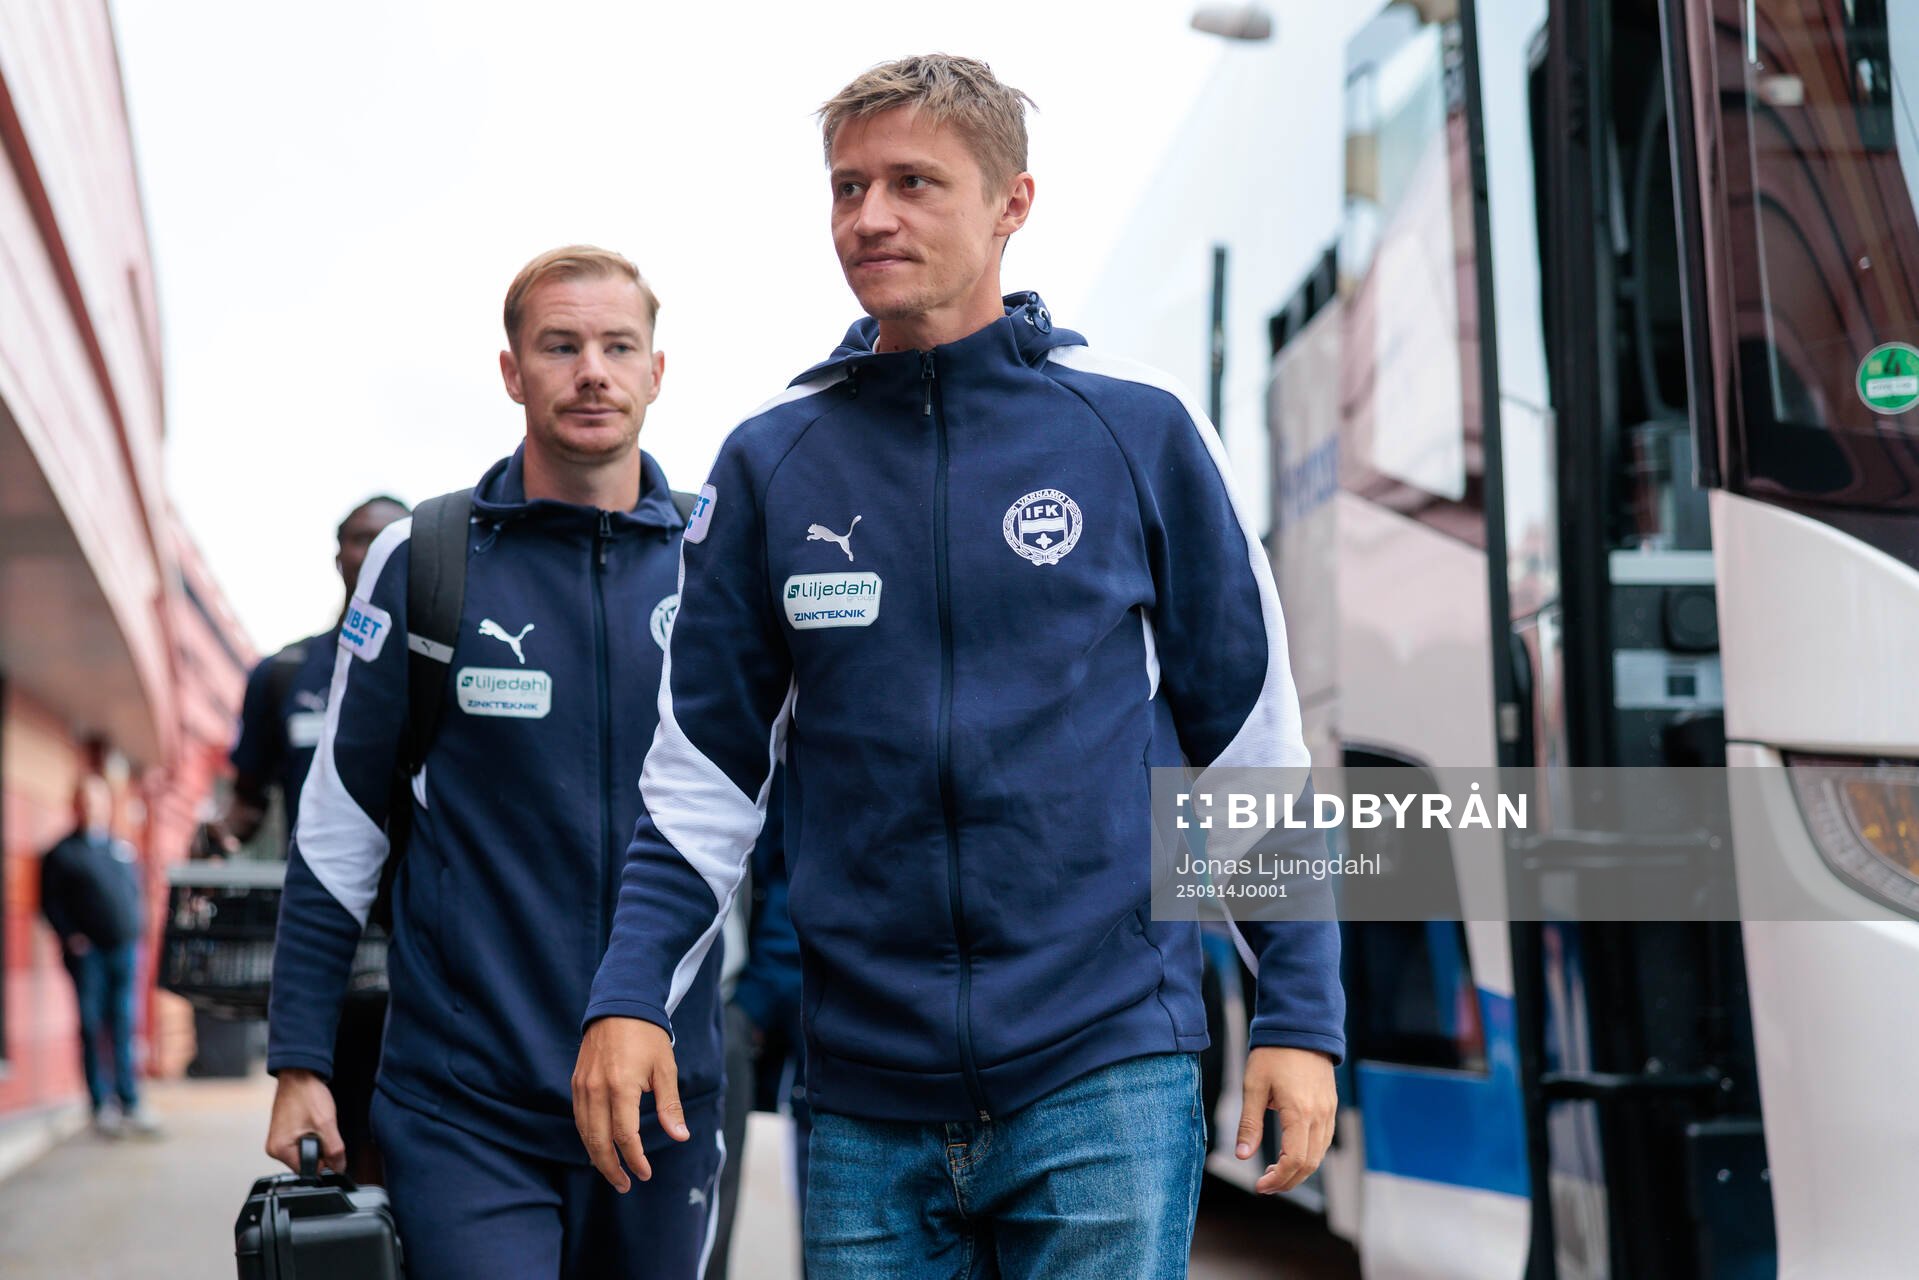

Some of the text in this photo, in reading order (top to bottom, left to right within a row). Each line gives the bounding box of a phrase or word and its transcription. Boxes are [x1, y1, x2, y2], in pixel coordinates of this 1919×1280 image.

[1025, 504, 1059, 519] IFK
[794, 609, 866, 621] ZINKTEKNIK
[467, 700, 539, 711] ZINKTEKNIK
